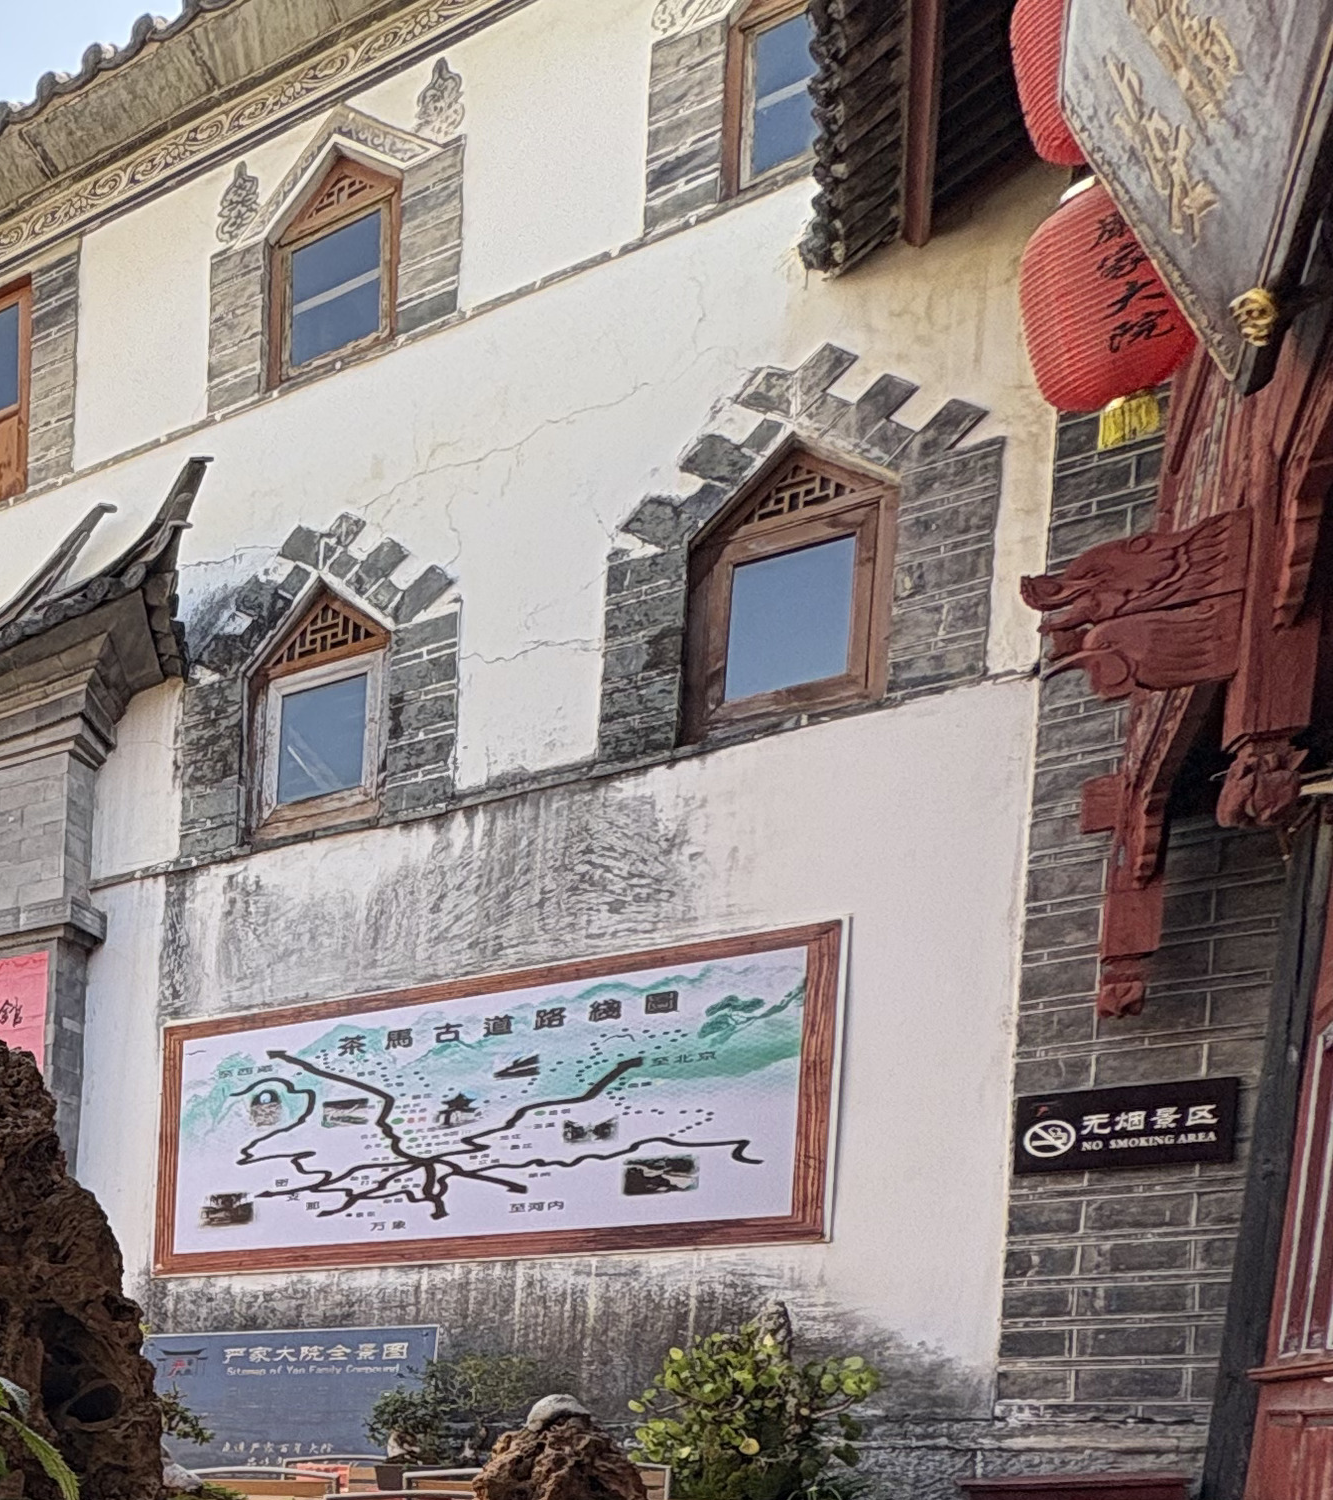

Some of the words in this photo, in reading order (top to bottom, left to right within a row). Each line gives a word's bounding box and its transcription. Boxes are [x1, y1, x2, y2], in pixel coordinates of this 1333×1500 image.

[1081, 1104, 1220, 1136] 无烟景区
[1081, 1140, 1104, 1152] NO
[1109, 1133, 1175, 1150] SMOKING
[1178, 1131, 1217, 1145] AREA
[222, 1342, 409, 1364] 严家大院全景图
